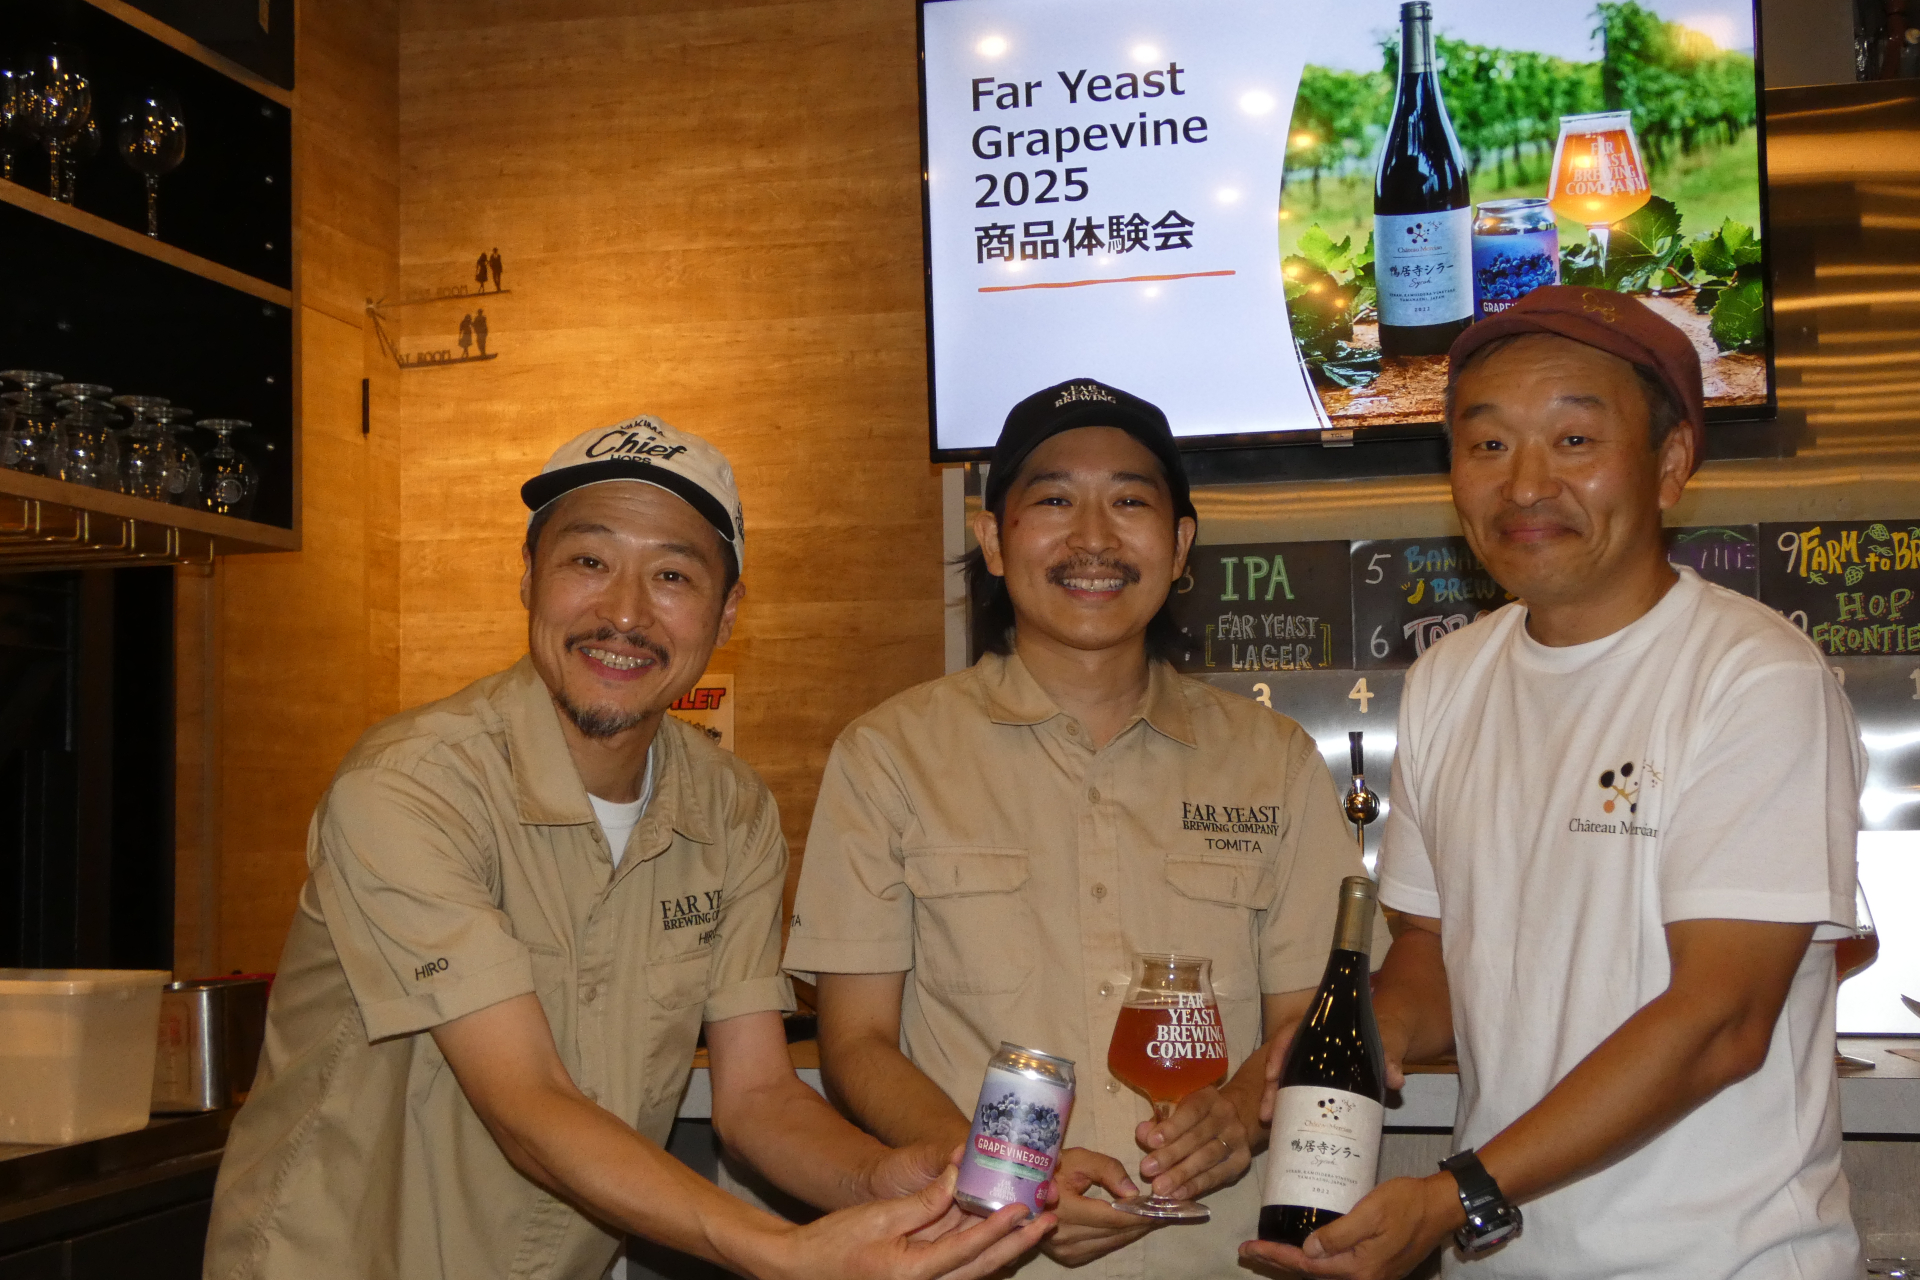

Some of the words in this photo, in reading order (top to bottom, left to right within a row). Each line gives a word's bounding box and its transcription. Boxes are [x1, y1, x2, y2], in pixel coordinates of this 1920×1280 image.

[972, 77, 1042, 111] Far
[1057, 62, 1185, 104] Yeast
[972, 112, 1208, 162] Grapevine
[975, 167, 1089, 208] 2025
[974, 210, 1195, 264] 商品体験会
[1054, 394, 1117, 408] BREWING
[585, 430, 687, 460] Chief
[1777, 531, 1799, 573] 9
[1799, 526, 1861, 578] FARM
[1865, 552, 1890, 572] to
[1220, 555, 1294, 601] IPA
[1365, 553, 1391, 585] 5
[1836, 588, 1914, 622] HOP
[1217, 611, 1257, 640] FAR
[1261, 612, 1320, 640] YEAST
[1370, 625, 1389, 658] 6
[1231, 643, 1312, 671] LAGER
[1348, 677, 1374, 713] 4
[1182, 801, 1218, 822] FAR
[1222, 805, 1279, 824] YEAST
[1568, 818, 1616, 834] Château
[1183, 820, 1229, 833] BREWING
[1231, 823, 1279, 836] COMPANY
[1204, 838, 1262, 853] TOMITA
[660, 894, 701, 920] FAR
[663, 912, 711, 931] BREWING
[414, 957, 449, 981] HIRO
[1178, 992, 1205, 1009] FAR
[1168, 1008, 1215, 1026] YEAST
[1157, 1024, 1223, 1042] BREWING
[977, 1137, 1049, 1167] GRAPEVINE2025
